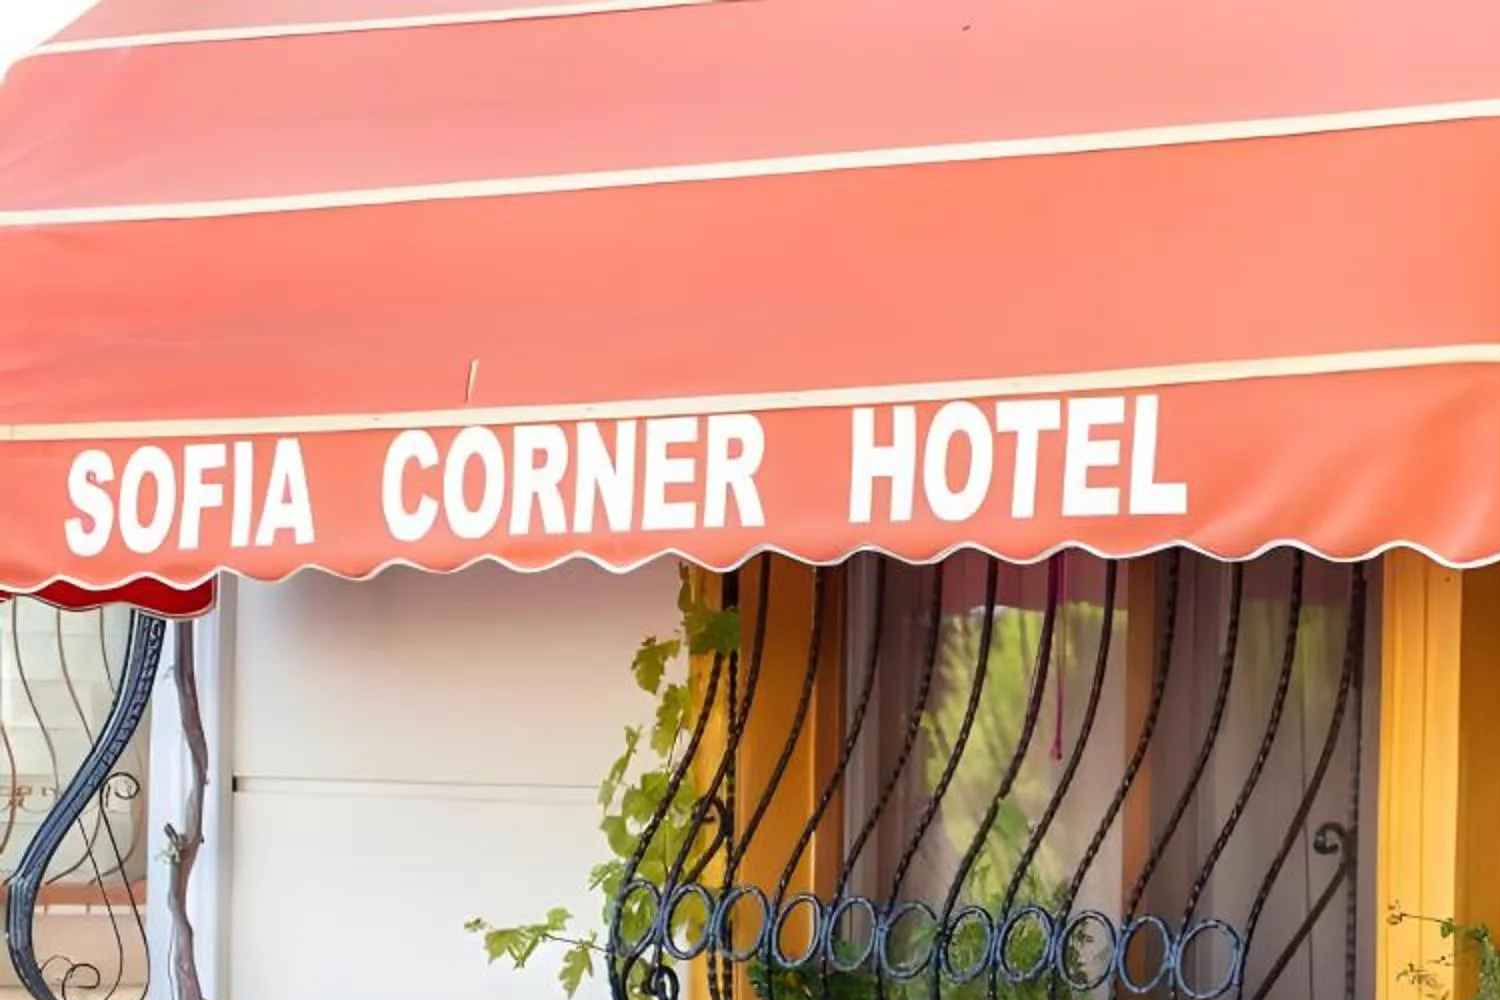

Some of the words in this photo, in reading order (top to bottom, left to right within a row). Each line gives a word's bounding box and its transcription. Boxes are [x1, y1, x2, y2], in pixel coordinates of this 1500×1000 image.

[64, 438, 315, 557] SOFIA
[382, 414, 765, 542] CORNER
[849, 395, 1187, 523] HOTEL
